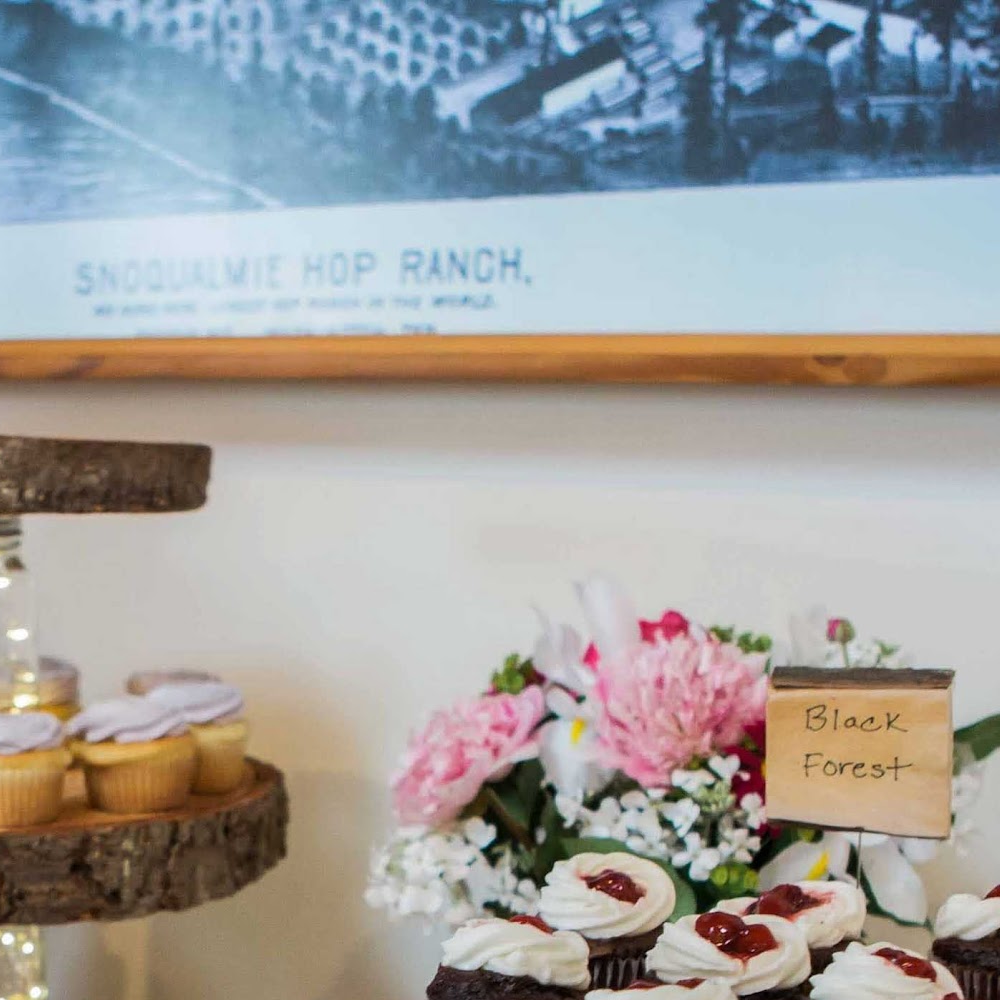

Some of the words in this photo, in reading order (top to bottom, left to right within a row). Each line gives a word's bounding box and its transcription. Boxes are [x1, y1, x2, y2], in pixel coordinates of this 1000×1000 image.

[302, 248, 378, 288] HOP
[804, 703, 909, 733] Black
[803, 752, 913, 782] Forest
